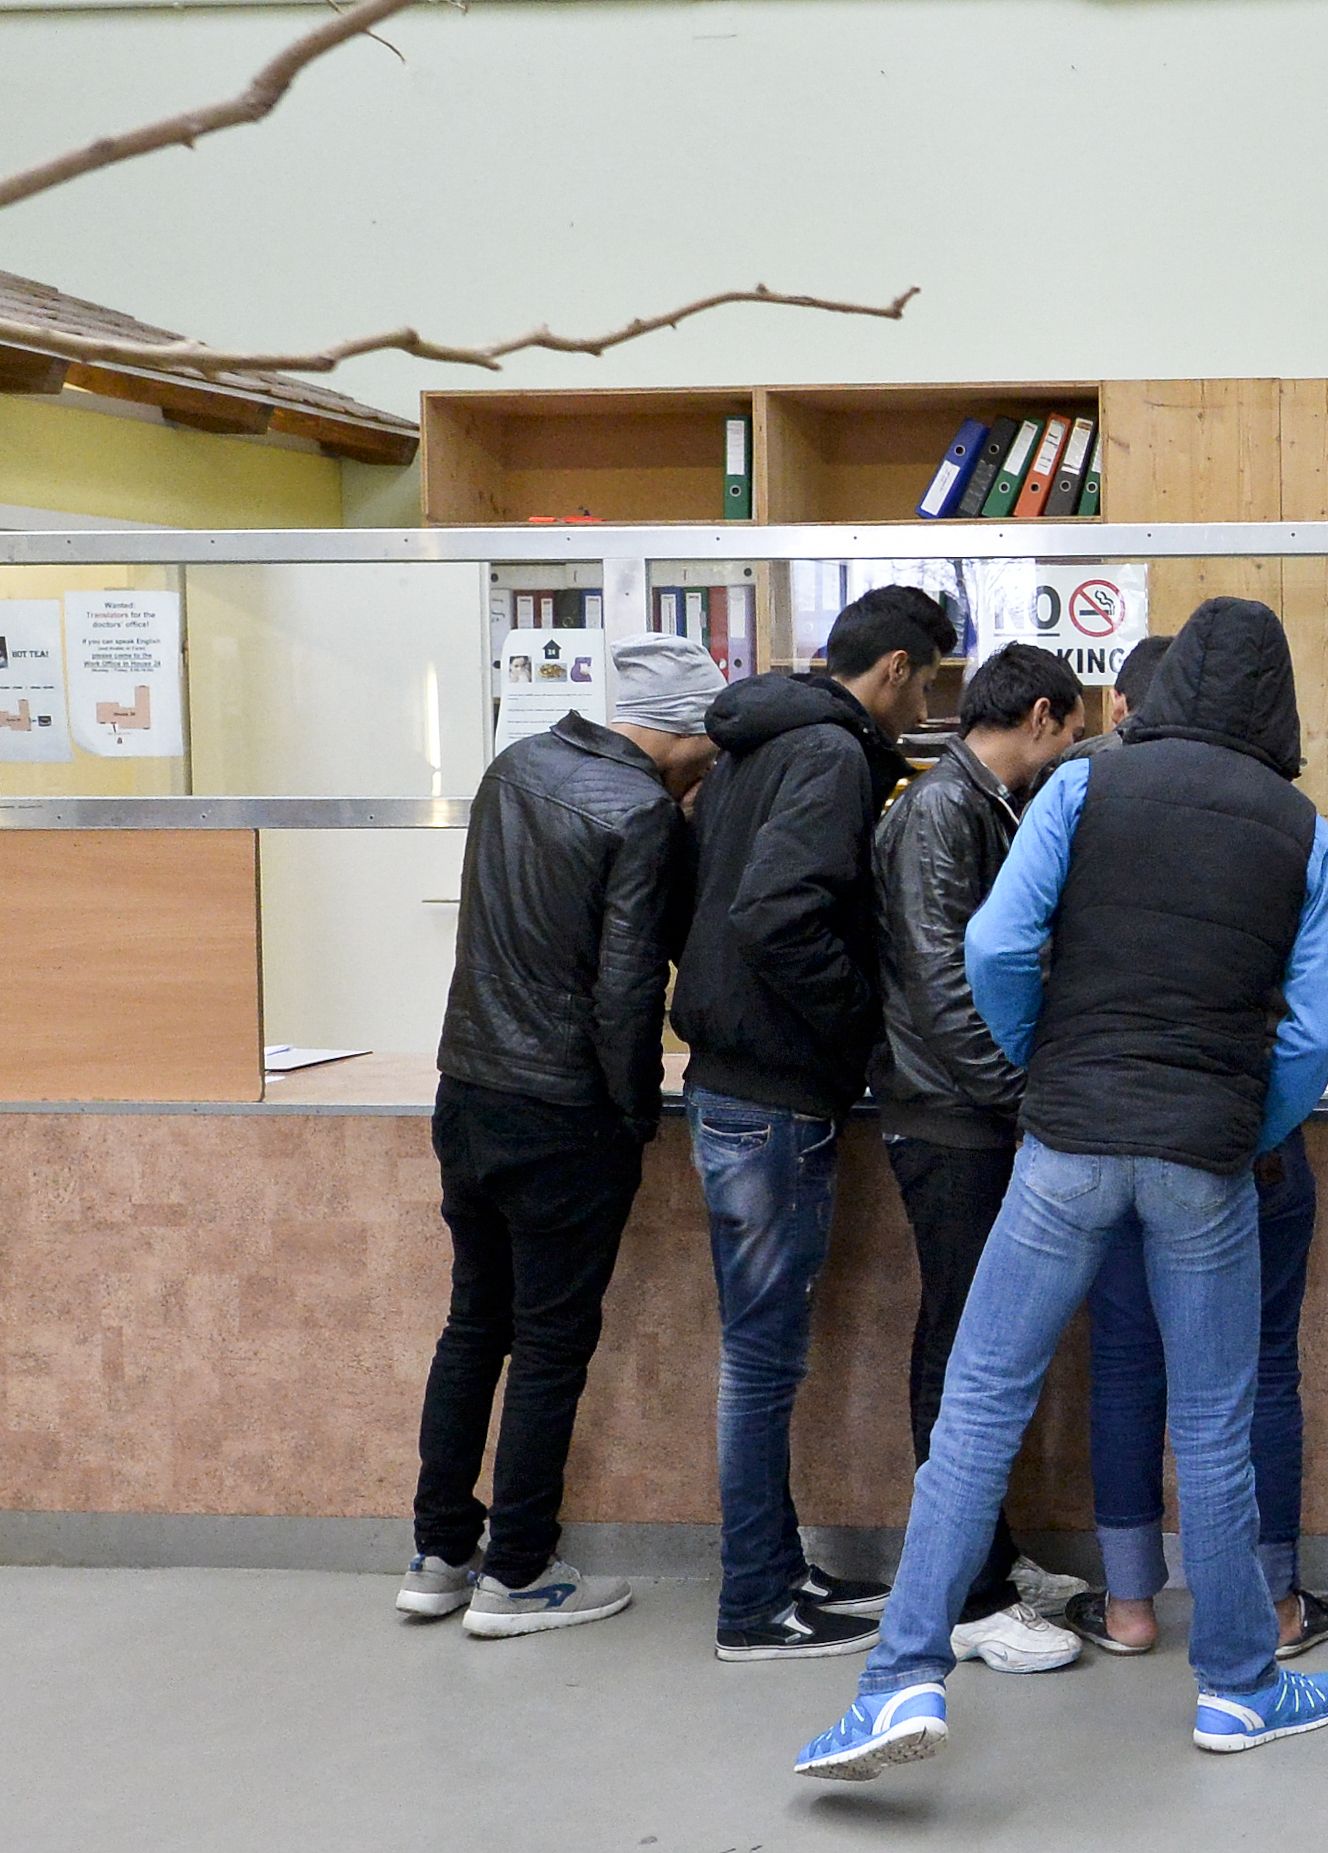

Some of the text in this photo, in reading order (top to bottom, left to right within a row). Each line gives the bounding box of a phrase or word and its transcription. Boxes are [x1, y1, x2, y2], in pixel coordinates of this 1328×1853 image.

[994, 586, 1061, 630] NO
[125, 620, 149, 628] office!
[29, 650, 49, 658] TEA!
[1057, 648, 1125, 674] KING
